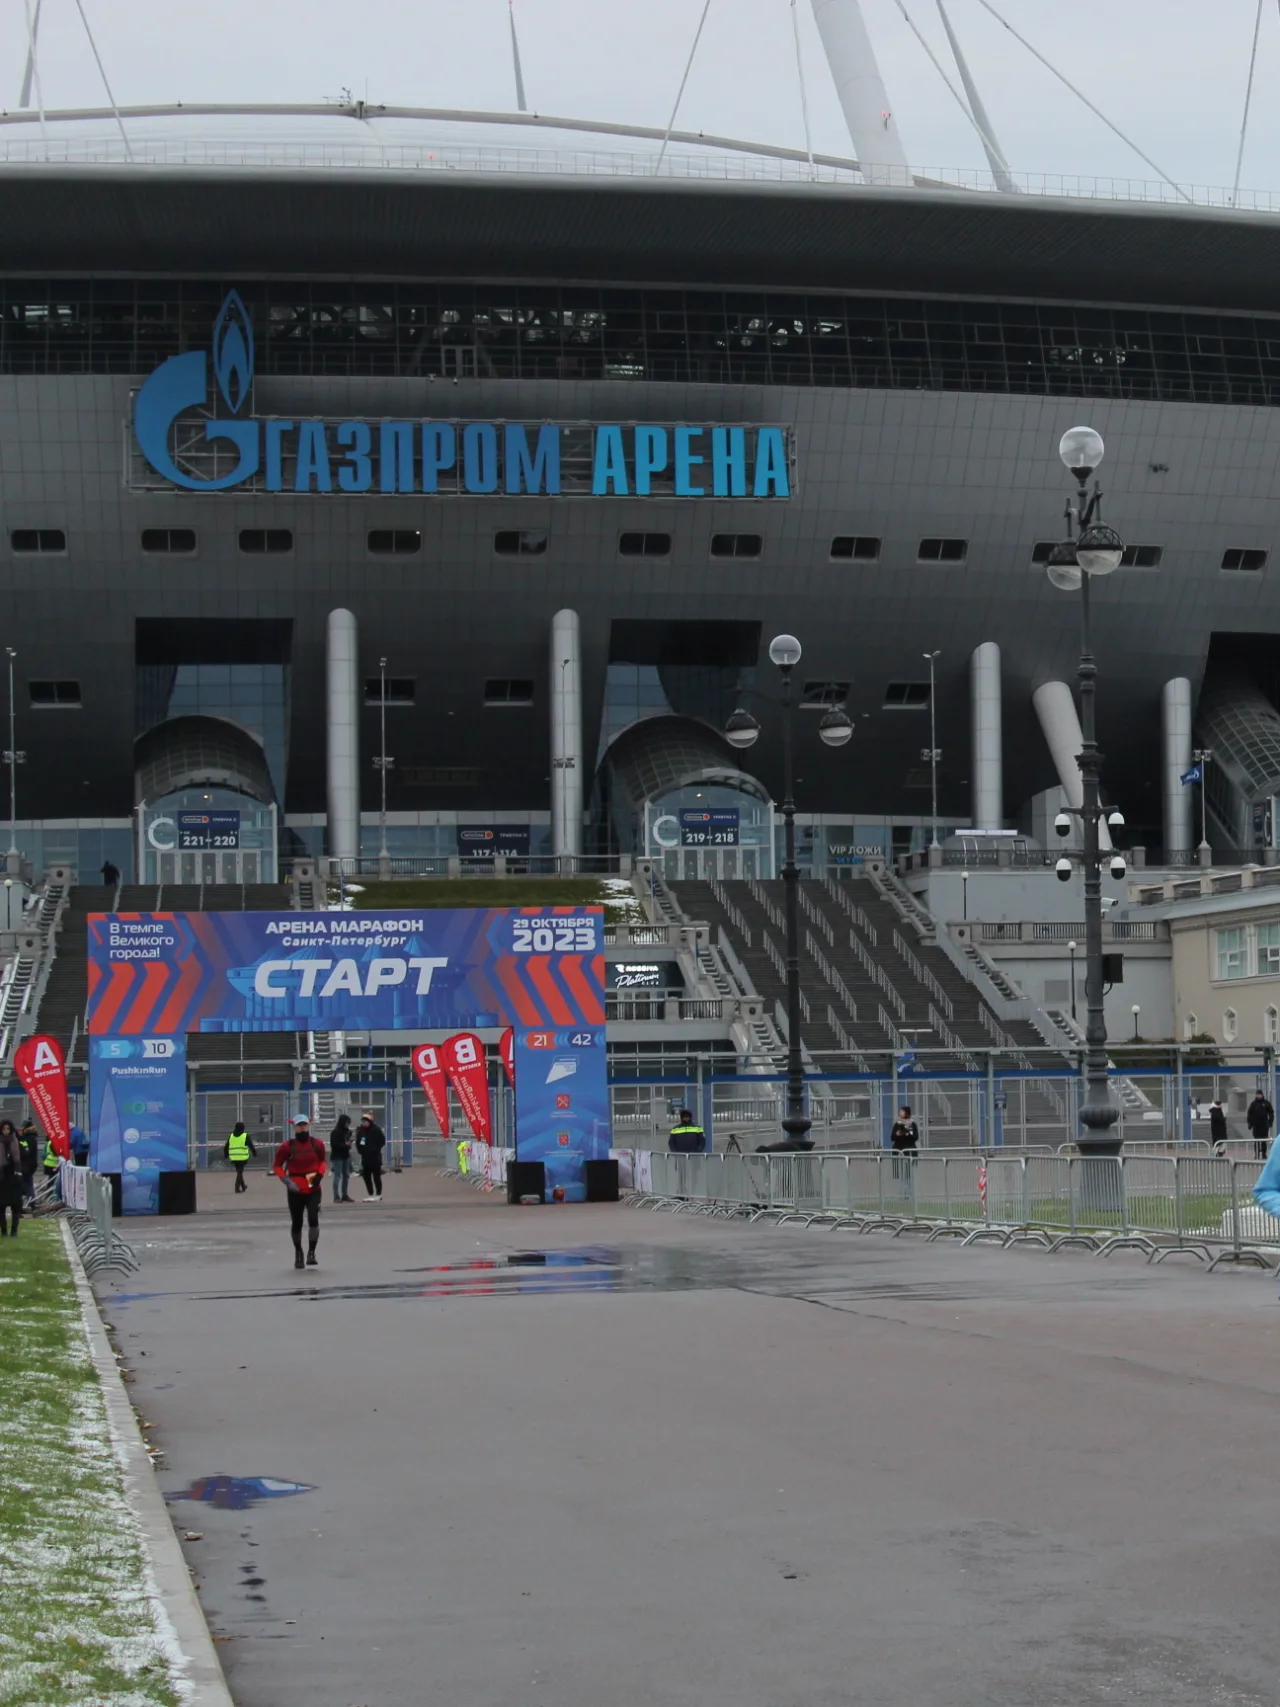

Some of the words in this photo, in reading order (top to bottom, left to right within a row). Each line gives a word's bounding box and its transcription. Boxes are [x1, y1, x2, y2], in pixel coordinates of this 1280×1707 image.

[265, 421, 560, 493] ГАЗПРОМ
[592, 425, 790, 497] АРЕНА
[829, 846, 846, 854] VIP
[848, 846, 881, 854] ЛОЖИ
[110, 923, 120, 933] В
[122, 924, 163, 933] темпе
[266, 921, 327, 934] АРЕНА
[331, 920, 423, 933] МАРАФОН
[513, 919, 528, 929] 29
[531, 918, 594, 928] ОКТЯБРЯ
[110, 936, 174, 946] Великого
[282, 935, 407, 948] Санкт-Петербург
[512, 928, 596, 952] 2023
[110, 947, 160, 960] города!
[255, 957, 448, 998] СТАРТ
[534, 1034, 547, 1046] 21
[572, 1033, 591, 1046] 42
[110, 1044, 121, 1055] 5
[152, 1043, 166, 1054] 10
